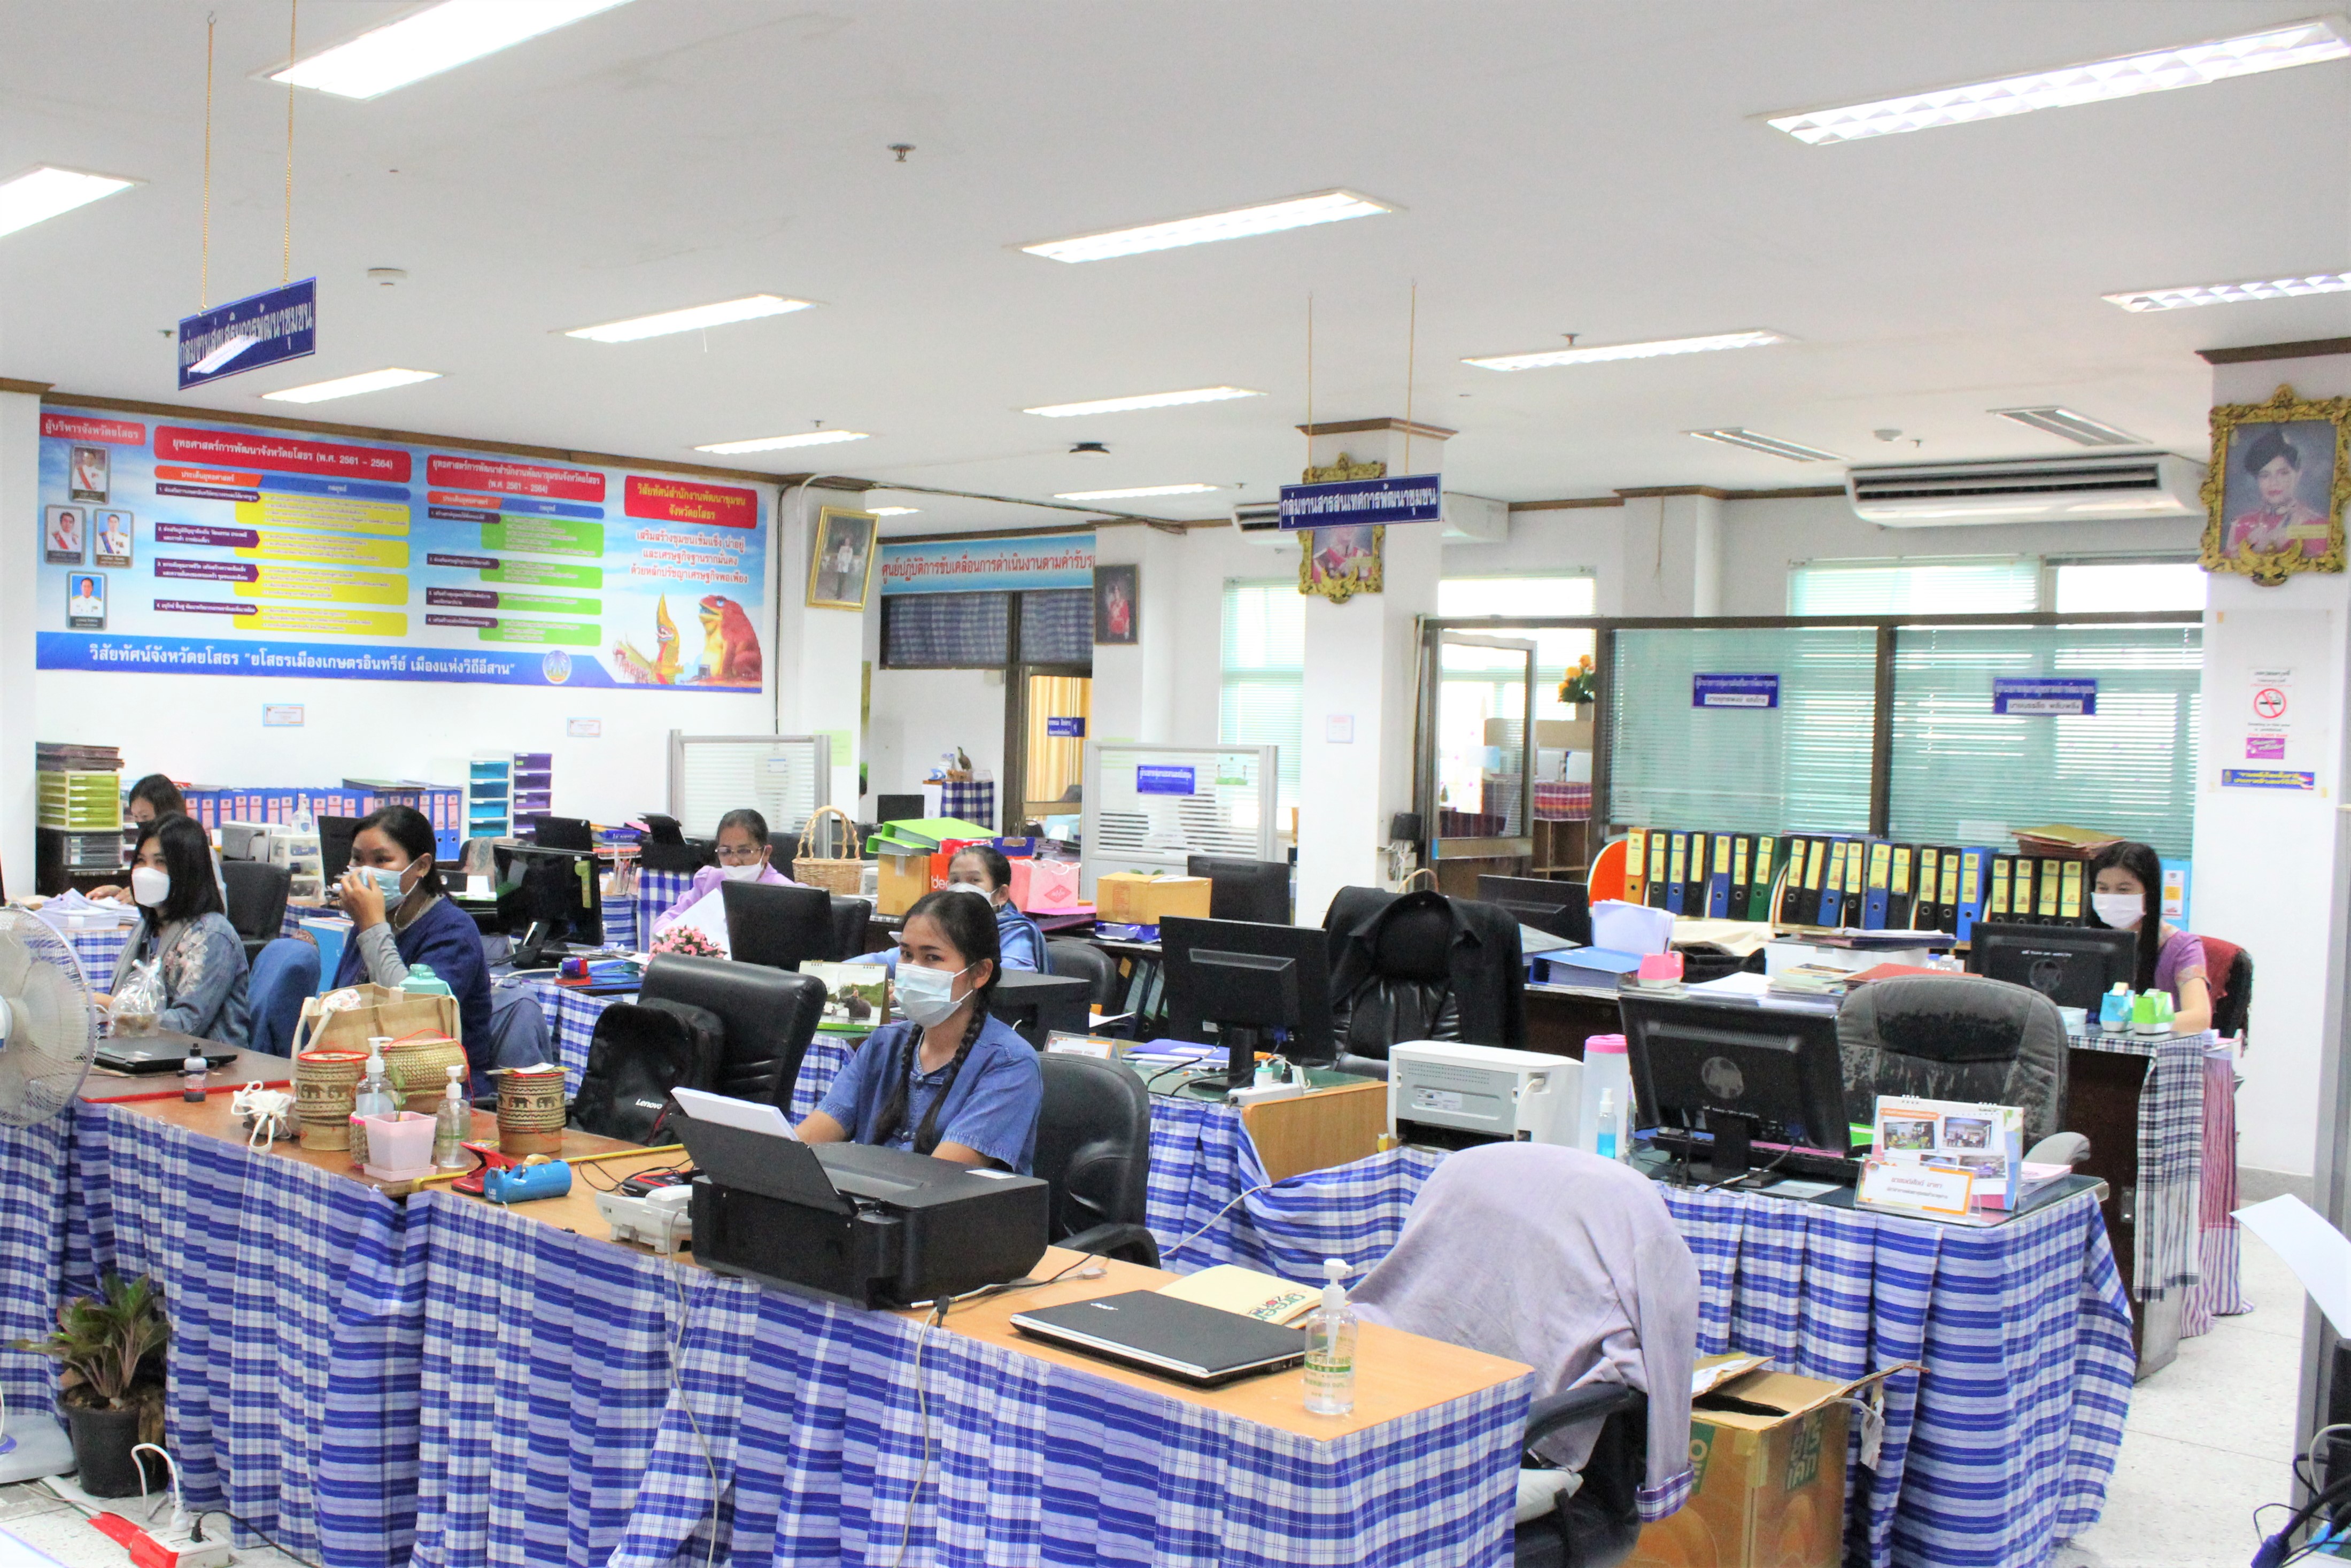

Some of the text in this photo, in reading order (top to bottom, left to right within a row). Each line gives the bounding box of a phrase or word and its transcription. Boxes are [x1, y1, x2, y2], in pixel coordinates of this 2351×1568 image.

[45, 420, 139, 438] ผู้บริหารจังหวัดยโสธร
[172, 438, 313, 460] ยุทธศาสตร์การพัฒนาจังหวัดยโสธร
[339, 455, 359, 465] 2561
[1282, 483, 1437, 524] กลุ่มงานสารสนเทศการพัฒนาชุมชน
[637, 529, 744, 552] เสริมสร้างชุมชนเข้มแข็ง น่าอยู่
[643, 550, 738, 566] และเศรษฐกิจฐานรากมั่นคง
[631, 563, 747, 584] ด้วยหลักปรัชญาเศรษฐกิจพอเพียง
[89, 643, 238, 665] วิสัยทัศน์จังหวัดยโสธร
[635, 1098, 663, 1109] Lenovo
